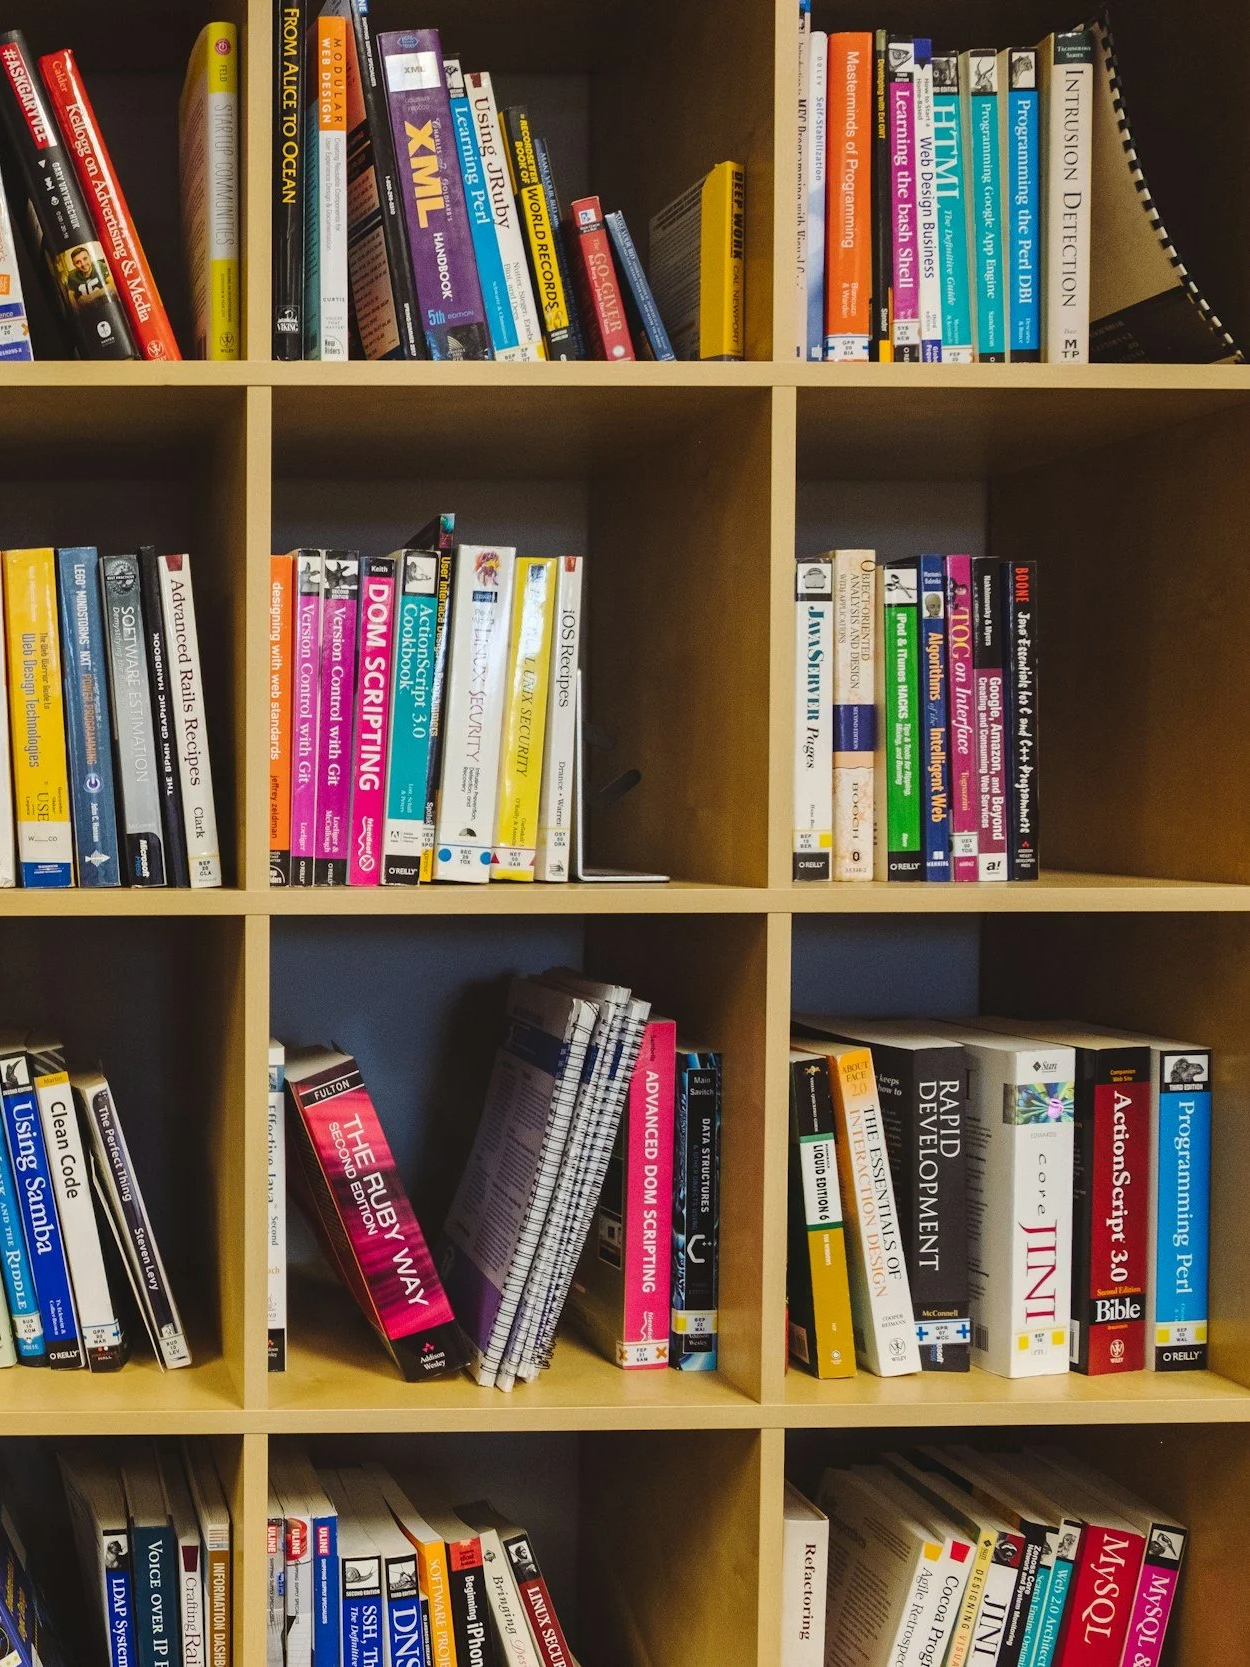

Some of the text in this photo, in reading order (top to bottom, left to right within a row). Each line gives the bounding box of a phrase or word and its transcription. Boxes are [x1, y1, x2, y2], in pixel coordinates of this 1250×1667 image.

[2, 48, 49, 143] #ASKGARYVEE
[282, 8, 299, 203] FROM ALICE TO OCEAN
[52, 162, 80, 229] GARY VAYNERCHUK
[65, 103, 151, 323] Kellogg on Advertising & Media
[405, 121, 444, 228] XML
[453, 106, 489, 224] Learning Perl
[920, 137, 937, 278] Web Design Business
[1015, 99, 1032, 303] Programming the Perl DBI
[731, 172, 744, 259] DEEP WORK
[433, 232, 452, 299] HANDBOOK
[1015, 567, 1028, 602] BOONE
[170, 580, 203, 786] Advanced Rails Recipes
[359, 583, 388, 791] DOM SCRIPTING
[399, 604, 417, 690] Cookbook
[412, 604, 432, 738] ActionScript 3.0
[557, 609, 575, 708] iOS Recipes
[951, 607, 972, 754] TOG on Interface
[960, 770, 970, 810] Tognazzini
[988, 677, 1004, 839] Google, Amazon, and Beyond
[193, 807, 205, 838] Clark
[50, 1102, 80, 1199] Clean Code
[98, 1105, 132, 1202] The Perfect Thing
[701, 1118, 711, 1212] DATA STRUCTURES
[940, 1081, 960, 1158] RAPID
[12, 1103, 51, 1255] Using Samba
[343, 1114, 428, 1307] THE RUBY WAY
[642, 1071, 659, 1292] ADVANCED DOM SCRIPTING
[919, 1081, 939, 1270] DEVELOPMENT
[1107, 1091, 1132, 1281] ActionScript 3.0
[1172, 1100, 1195, 1294] Programming Perl
[1018, 1220, 1057, 1323] JINI
[1095, 1301, 1140, 1322] Bible
[320, 1527, 328, 1553] ULINE
[112, 1579, 126, 1616] LDAP
[213, 1563, 226, 1630] INFORMATION
[491, 1576, 518, 1635] Bringing
[526, 1587, 550, 1627] LINUX
[799, 1544, 816, 1640] Refactoring
[937, 1576, 959, 1625] Cocoa
[974, 1595, 1007, 1655] JINI
[1082, 1535, 1129, 1644] MySQL
[1137, 1575, 1170, 1647] MySQL
